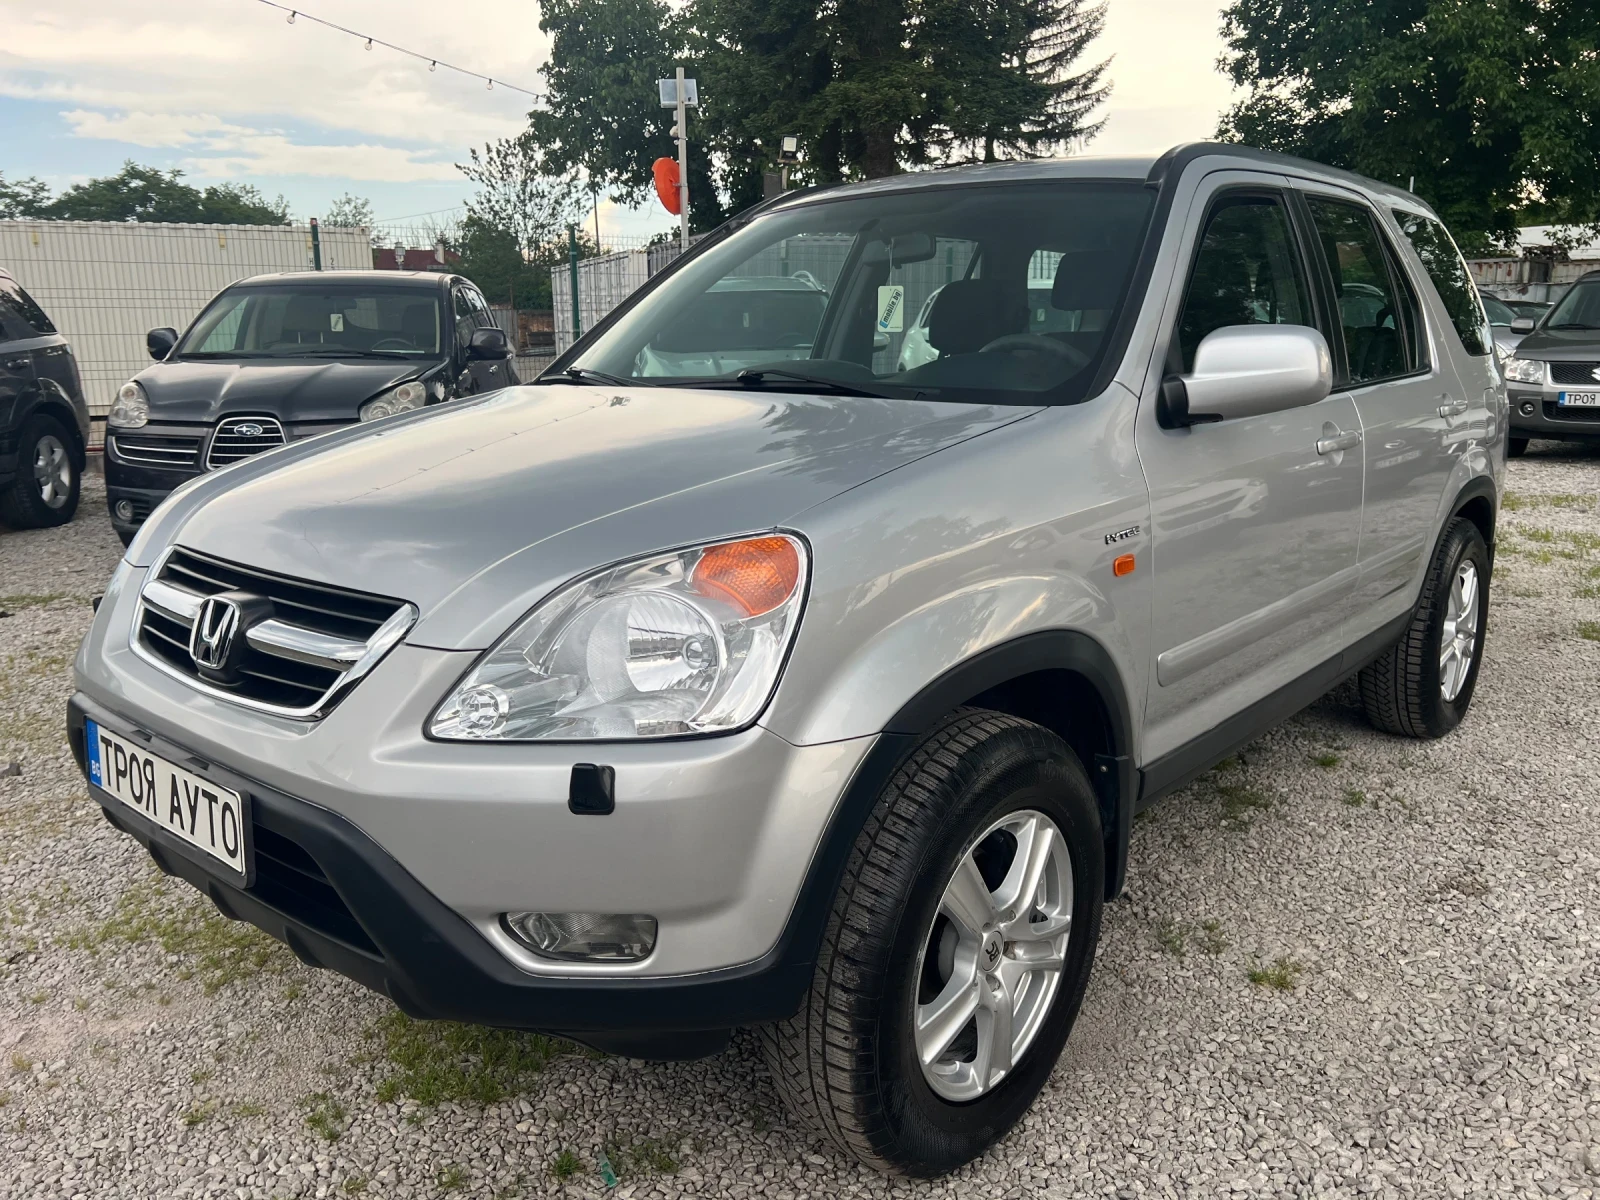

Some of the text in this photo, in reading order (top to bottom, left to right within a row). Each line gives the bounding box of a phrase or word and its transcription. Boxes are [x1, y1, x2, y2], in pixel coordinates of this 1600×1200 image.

[1567, 394, 1596, 404] ТРОЯ
[91, 760, 100, 777] BG
[100, 735, 239, 859] ТРОЯ АУТО
